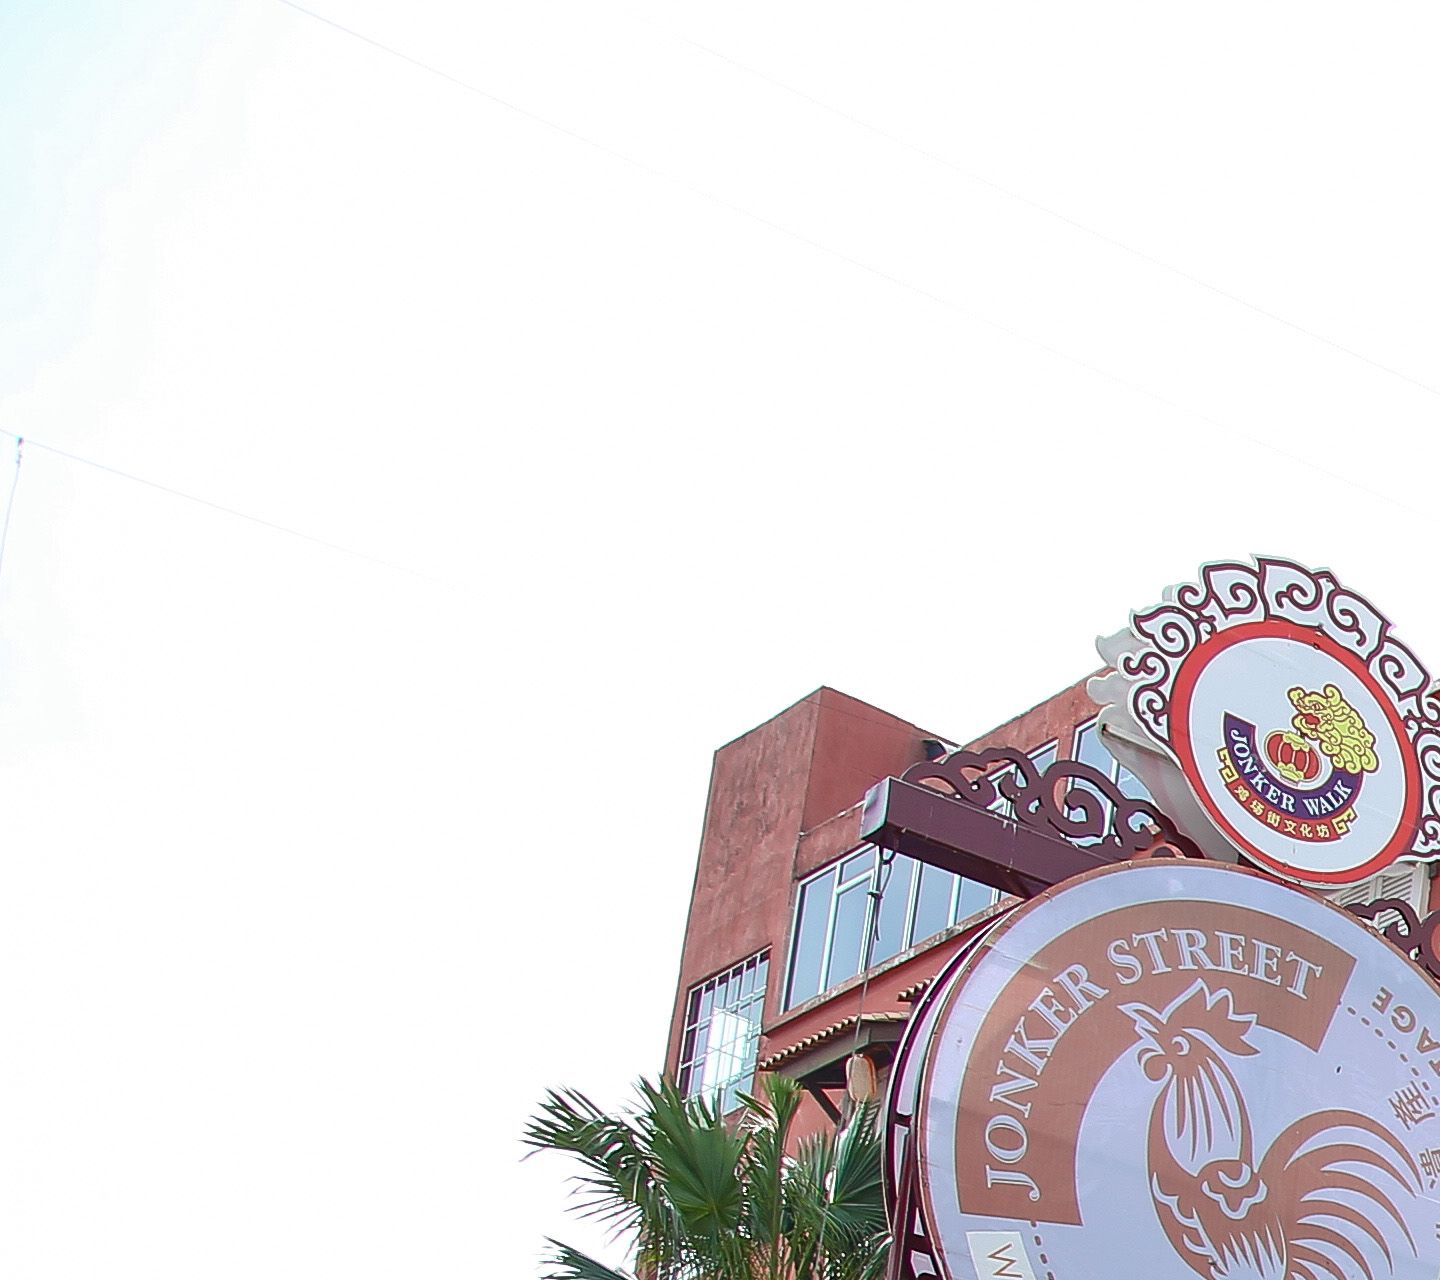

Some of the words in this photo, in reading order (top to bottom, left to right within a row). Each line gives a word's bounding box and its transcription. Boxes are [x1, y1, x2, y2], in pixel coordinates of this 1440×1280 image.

[1230, 728, 1297, 814] JONKER
[1302, 779, 1353, 818] WALK
[984, 962, 1110, 1202] JONKER
[1106, 927, 1324, 1000] STREET
